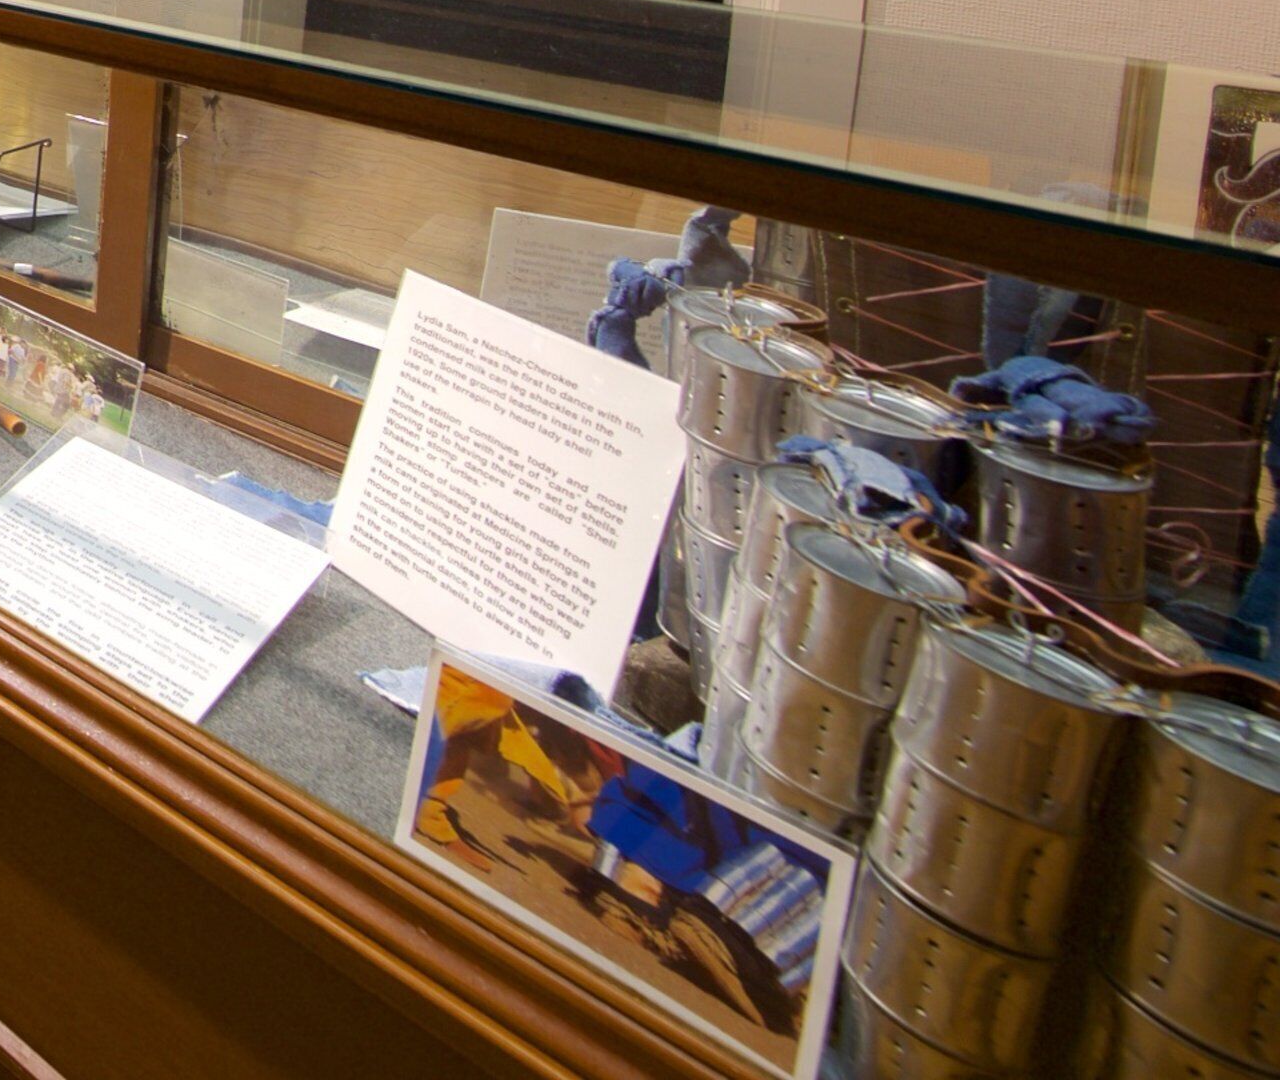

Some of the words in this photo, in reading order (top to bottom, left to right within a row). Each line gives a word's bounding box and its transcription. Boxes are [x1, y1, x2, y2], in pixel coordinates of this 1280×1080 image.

[399, 367, 438, 394] shakers.
[402, 358, 420, 371] use
[421, 365, 433, 377] of
[433, 371, 451, 386] the
[450, 380, 492, 409] terrapin
[492, 400, 506, 417] by
[508, 408, 536, 429] head
[536, 422, 562, 445] lady
[563, 436, 593, 457] shell
[407, 344, 437, 365] 1920s.
[439, 360, 468, 380] Some
[468, 374, 507, 402] ground
[507, 393, 549, 420] leaders
[550, 414, 583, 437] insist
[584, 433, 600, 446] on
[602, 439, 623, 457] the
[409, 332, 464, 365] condensed
[464, 358, 486, 376] milk
[488, 372, 508, 386] can
[509, 380, 527, 398] leg
[528, 389, 579, 420] shackles
[580, 413, 593, 427] in
[594, 420, 615, 437] the
[413, 321, 477, 357] traditionalist,
[478, 353, 500, 368] was
[501, 361, 519, 377] the
[520, 370, 543, 388] first
[544, 382, 558, 395] to
[558, 388, 595, 412] dance
[596, 405, 623, 425] with
[624, 419, 645, 436] tin,
[416, 309, 444, 330] Lydia
[445, 322, 470, 340] Sam,
[471, 336, 479, 344] a
[480, 338, 579, 390] Natchez-Cherokee
[377, 440, 395, 456] The
[395, 450, 435, 482] practice
[436, 473, 448, 487] of
[447, 480, 478, 506] using
[479, 497, 527, 532] shackles
[528, 526, 561, 552] made
[562, 545, 591, 569] from
[382, 424, 424, 455] Shakers"
[426, 451, 437, 462] or
[439, 456, 487, 489] "Turtles."
[385, 414, 421, 441] Women
[425, 437, 458, 464] stomp
[463, 457, 506, 488] dancers
[512, 487, 530, 501] are
[537, 498, 573, 524] called
[580, 521, 617, 549] "Shell
[387, 404, 424, 432] moving
[424, 426, 438, 441] up
[440, 432, 452, 445] to
[452, 439, 488, 468] having
[490, 459, 516, 480] their
[517, 476, 541, 494] own
[544, 488, 563, 505] set
[564, 499, 578, 514] of
[580, 508, 620, 537] shells.
[391, 396, 425, 419] women
[427, 413, 451, 432] start
[452, 426, 470, 443] out
[472, 437, 495, 456] with
[497, 453, 505, 461] a
[507, 455, 525, 472] set
[527, 466, 540, 480] of
[543, 474, 581, 502] "cans"
[584, 496, 624, 525] before
[394, 384, 415, 401] This
[420, 397, 462, 426] tradition
[467, 422, 520, 457] continues
[526, 453, 559, 480] today
[565, 473, 589, 493] and
[595, 489, 628, 514] most
[349, 531, 372, 553] front
[372, 547, 383, 561] of
[383, 554, 410, 579] them.
[356, 509, 366, 522] in
[366, 515, 382, 532] the
[383, 526, 436, 567] ceremonial
[436, 560, 471, 590] dance,
[472, 584, 485, 599] to
[485, 592, 515, 618] allow
[516, 612, 545, 638] shell
[359, 497, 379, 516] milk
[380, 513, 397, 528] can
[399, 522, 444, 558] shackles,
[446, 552, 481, 581] unless
[482, 575, 507, 600] they
[508, 593, 526, 610] are
[527, 603, 572, 641] leading
[363, 486, 372, 498] is
[373, 492, 426, 531] considered
[426, 525, 478, 566] respectful
[478, 557, 495, 574] for
[496, 568, 528, 595] those
[529, 588, 555, 611] who
[555, 607, 585, 630] wear
[366, 474, 398, 500] moved
[399, 496, 412, 509] on
[413, 502, 424, 516] to
[424, 510, 454, 537] using
[455, 527, 472, 545] the
[473, 539, 503, 564] turtle
[504, 557, 540, 587] shells.
[542, 581, 580, 613] Today
[581, 604, 590, 617] it
[370, 465, 376, 473] a
[377, 467, 400, 487] form
[401, 481, 412, 494] of
[412, 488, 451, 520] training
[452, 511, 468, 527] for
[468, 524, 502, 551] young
[503, 542, 530, 567] girls
[530, 558, 569, 588] before
[569, 581, 597, 608] they
[373, 451, 393, 469] milk
[394, 465, 417, 484] cans
[418, 477, 470, 517] originated
[471, 508, 482, 521] at
[483, 515, 533, 551] Medicine
[533, 545, 580, 582] Springs
[581, 575, 596, 589] as
[352, 520, 389, 551] shakers
[389, 545, 411, 566] with
[411, 559, 438, 584] turtle
[439, 577, 471, 605] shells
[471, 598, 484, 614] to
[484, 607, 523, 642] always
[524, 633, 540, 651] be
[541, 644, 554, 660] in
